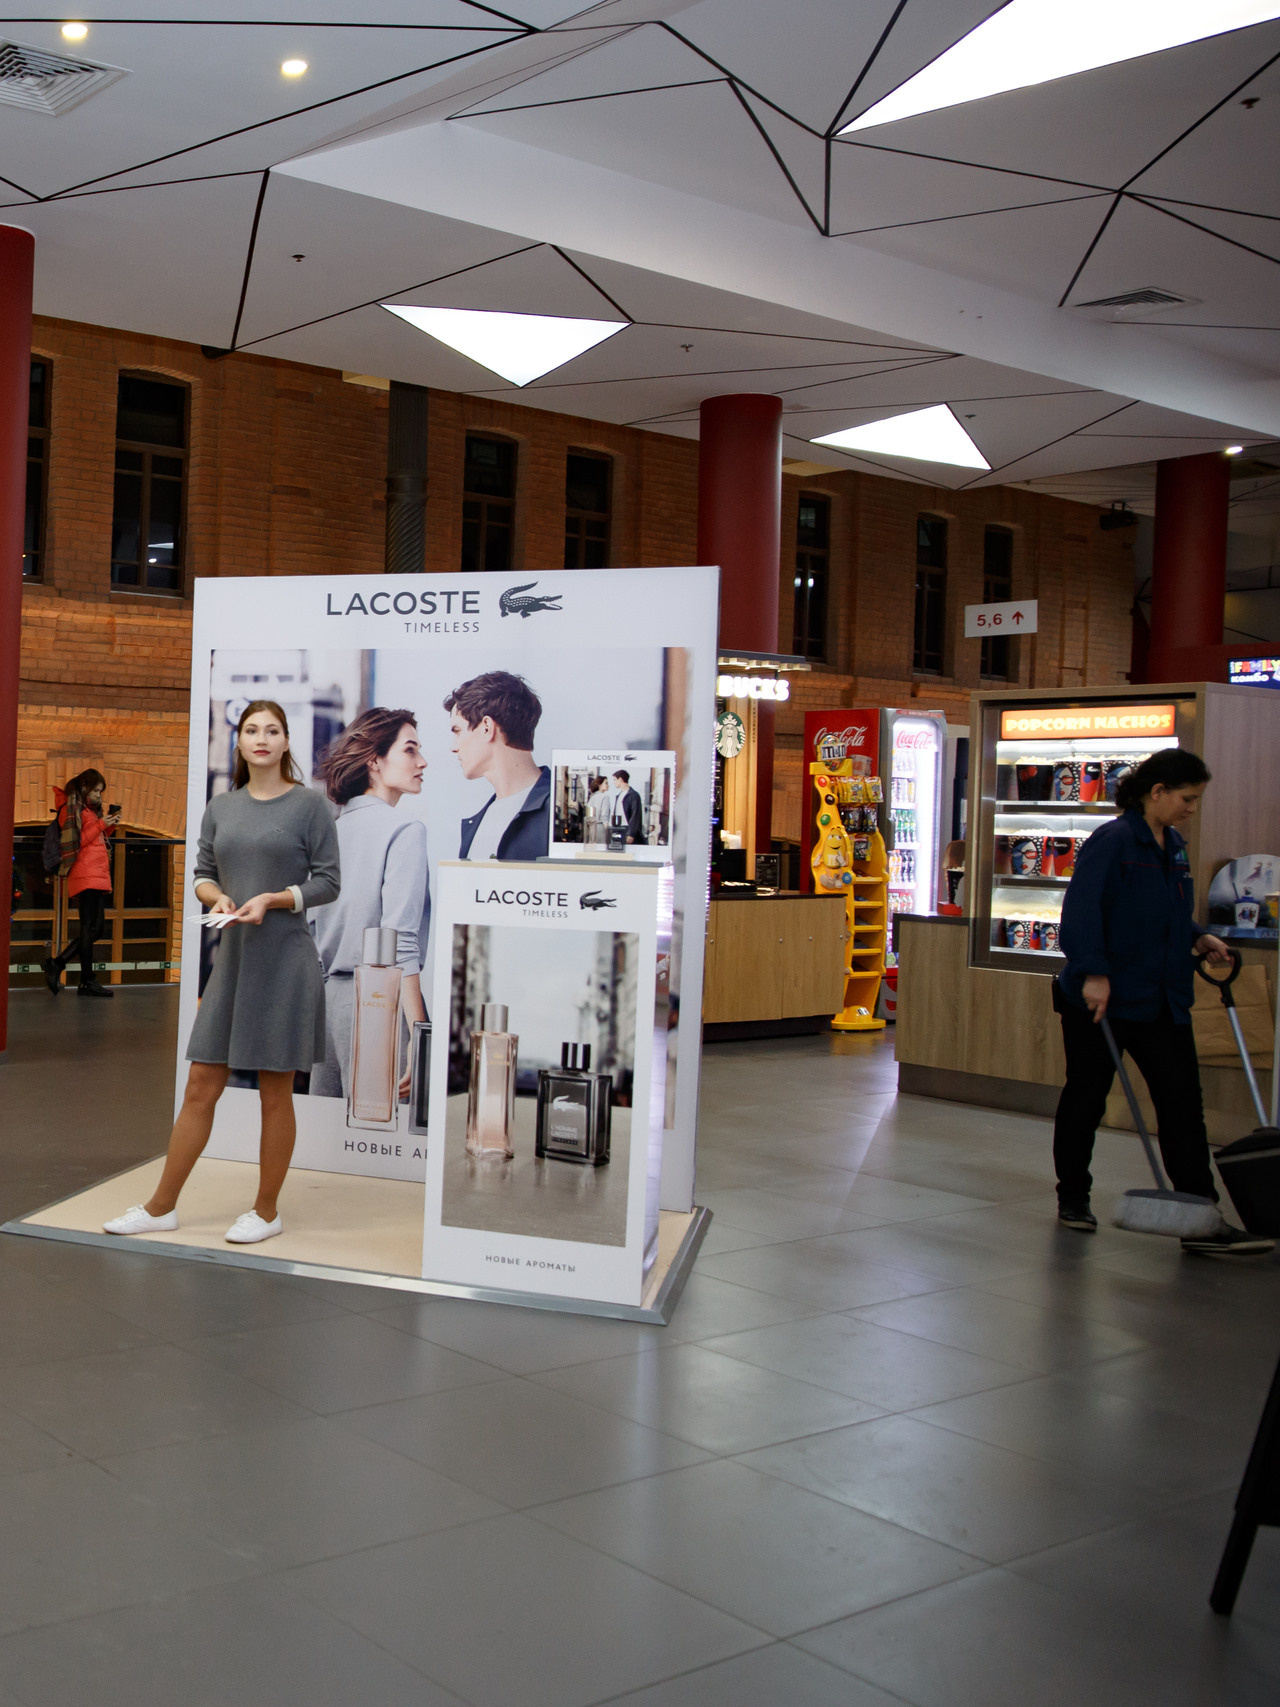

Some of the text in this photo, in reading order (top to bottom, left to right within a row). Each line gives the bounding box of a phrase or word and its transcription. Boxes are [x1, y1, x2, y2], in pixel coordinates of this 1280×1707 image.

[326, 590, 481, 616] LACOSTE
[404, 621, 480, 633] TIMELESS
[976, 613, 1003, 628] 5,6
[716, 675, 790, 701] BUCKS
[1005, 714, 1172, 732] POPCORN NACHOS
[475, 889, 569, 907] LACOSTE
[522, 909, 569, 918] TIMELESS
[344, 1140, 402, 1157] НОВЫЕ
[485, 1255, 576, 1272] НОВЫЕ АРОМАТЫ
